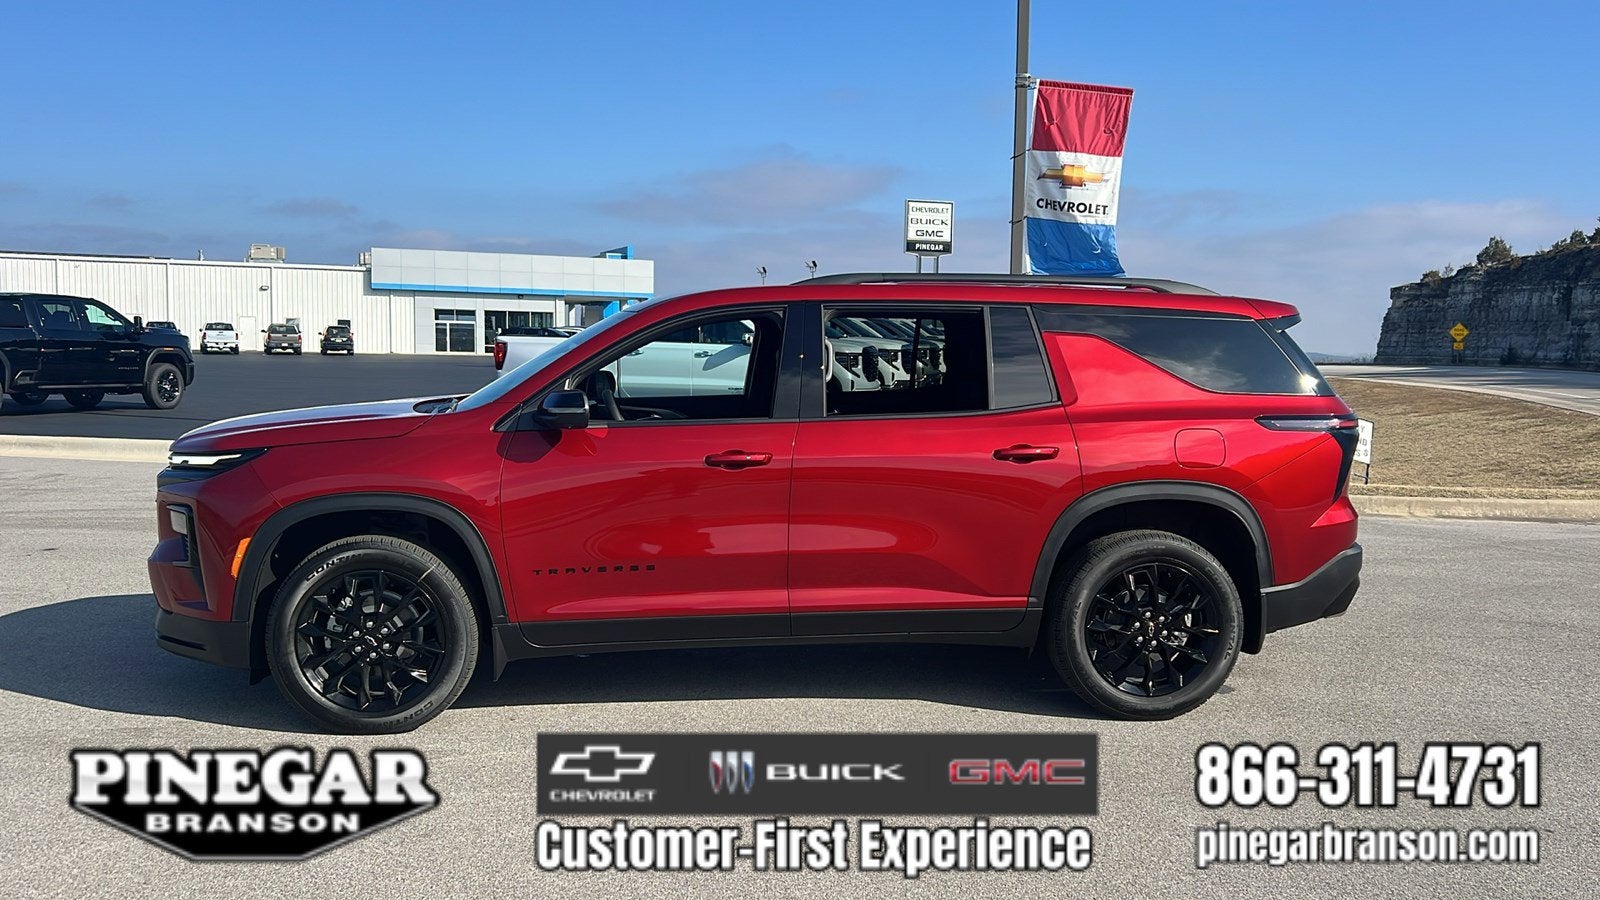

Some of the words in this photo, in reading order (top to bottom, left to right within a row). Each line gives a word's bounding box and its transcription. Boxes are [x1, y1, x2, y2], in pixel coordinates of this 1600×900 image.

[911, 206, 949, 214] CHEVROLET
[910, 217, 949, 226] BUICK
[915, 229, 944, 238] GMC
[915, 243, 944, 251] PINEGAR
[532, 565, 656, 576] TRAVERSE
